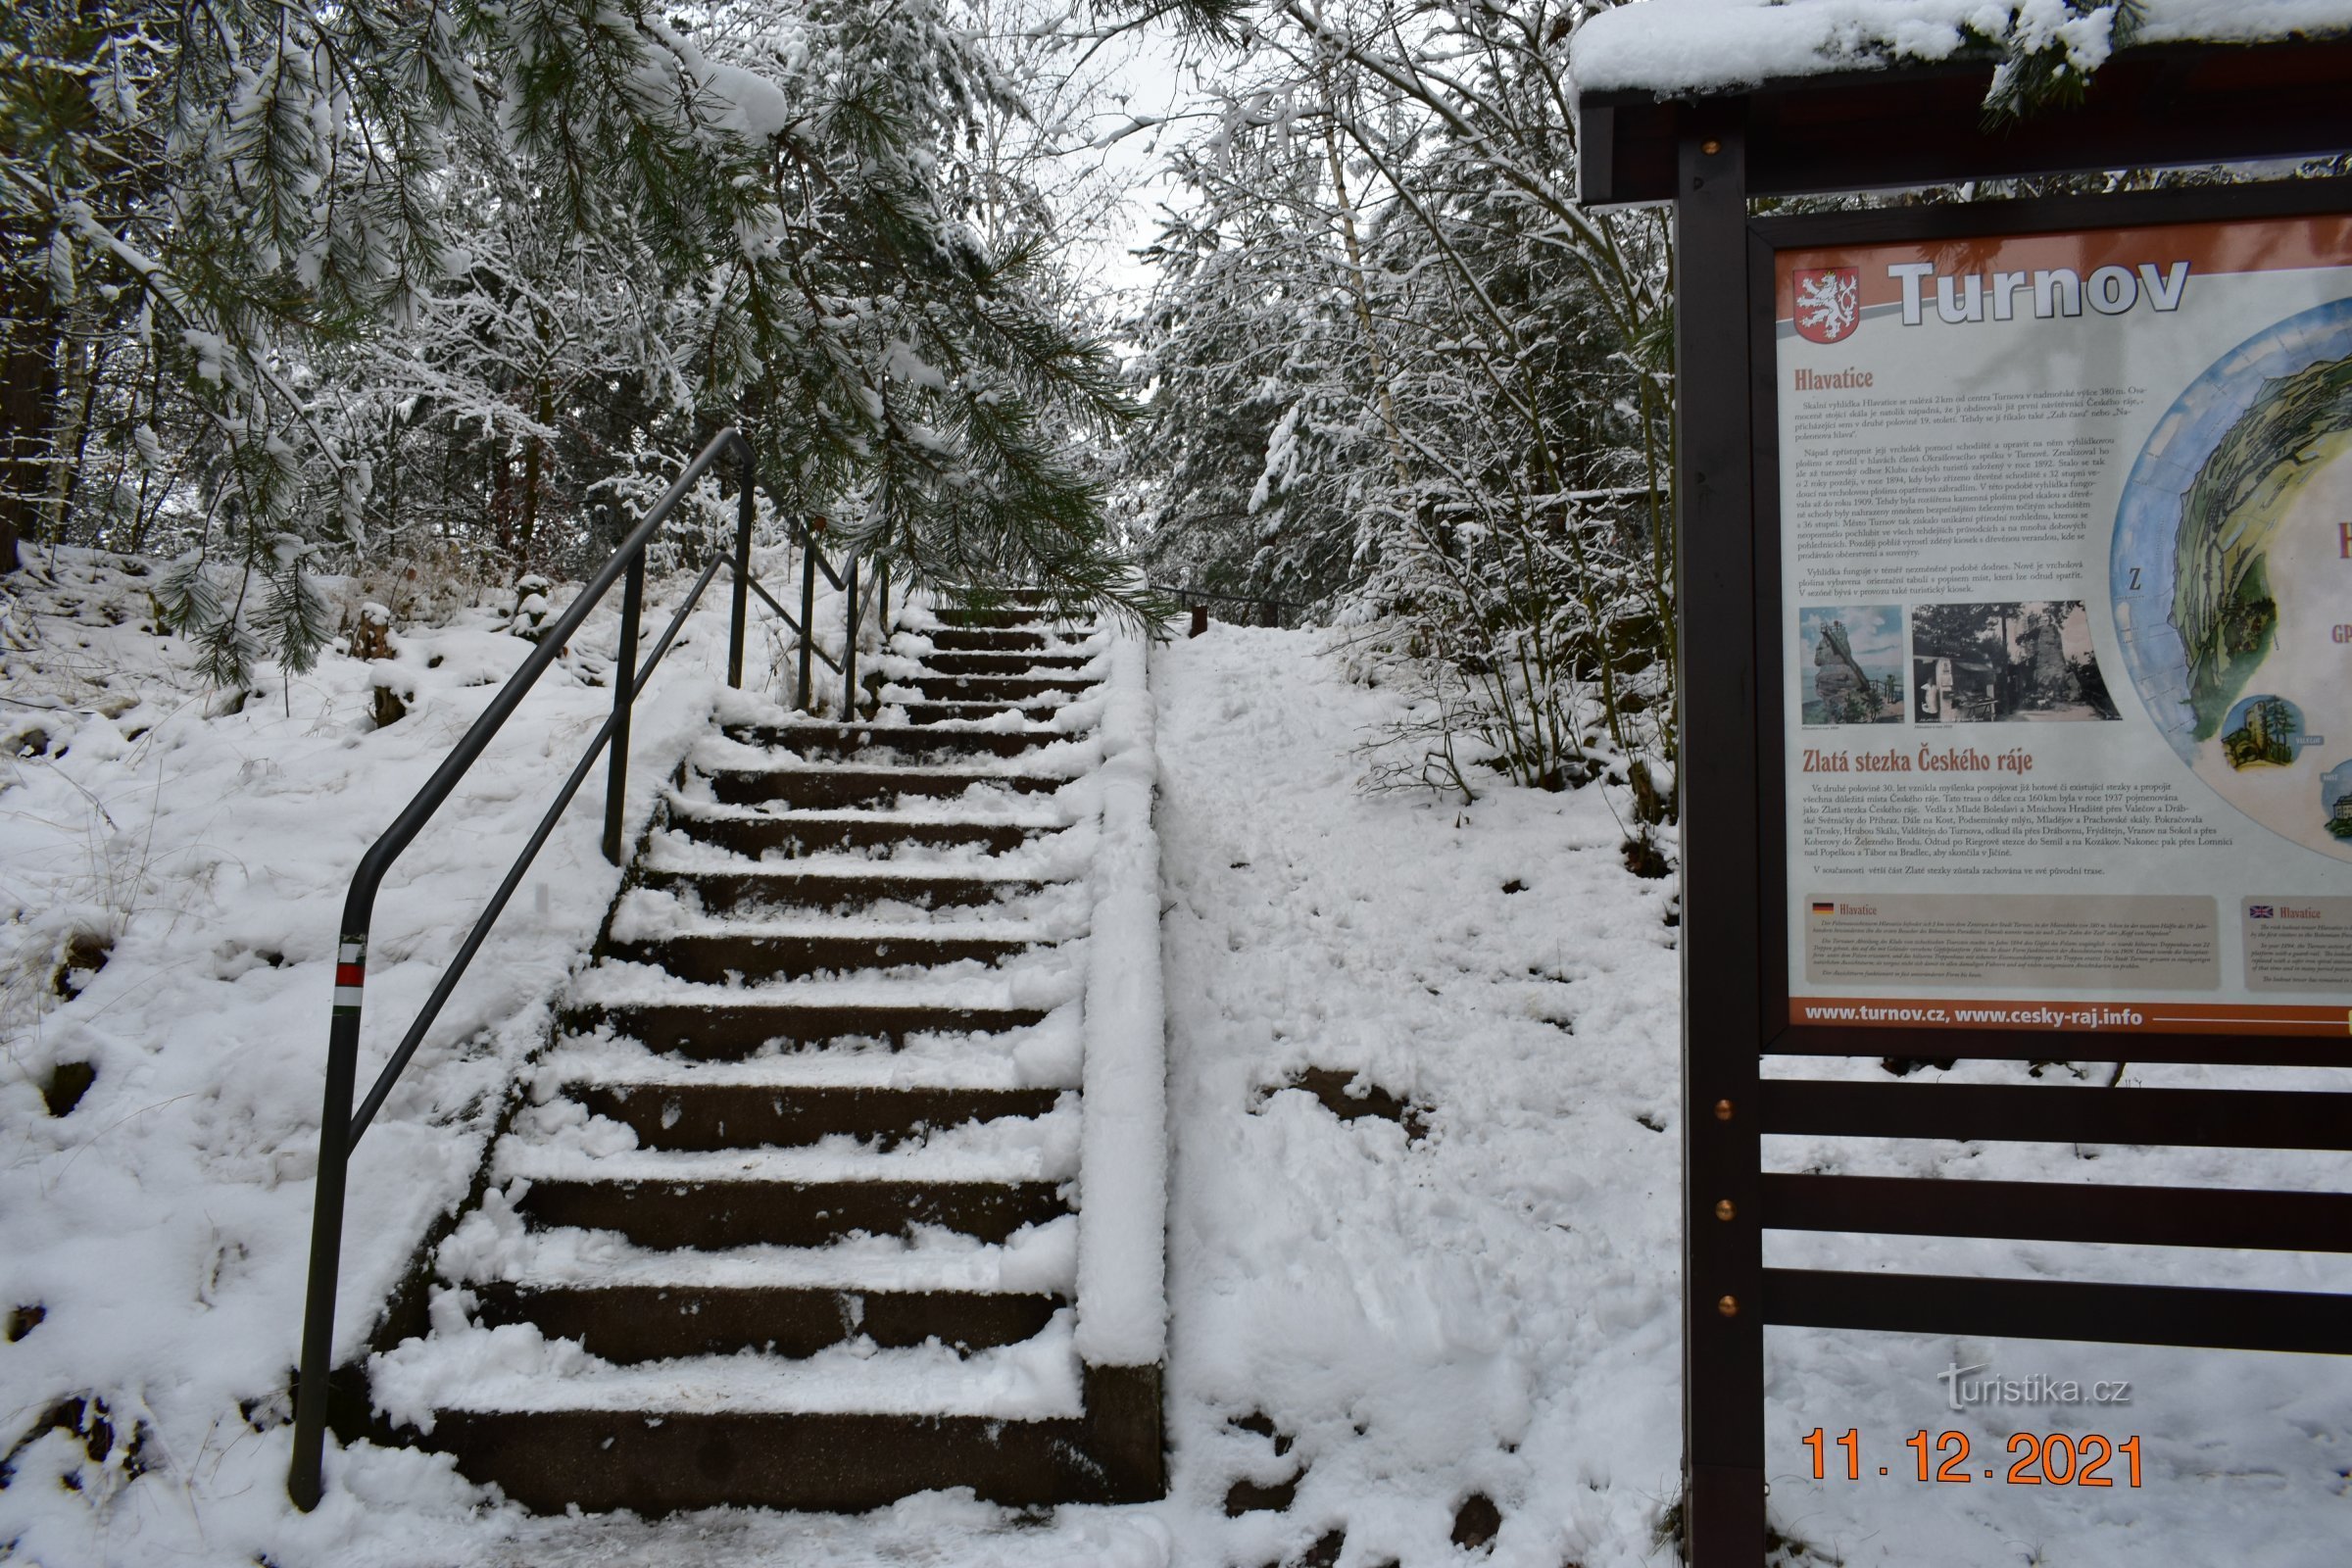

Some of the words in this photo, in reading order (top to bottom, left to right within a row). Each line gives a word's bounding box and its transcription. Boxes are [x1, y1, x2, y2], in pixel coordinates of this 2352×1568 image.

[1887, 261, 2191, 325] Turnov
[1794, 368, 1873, 391] Hlavatice
[2128, 567, 2141, 590] Z
[1803, 749, 1849, 772] Zlatá
[1855, 749, 1911, 772] stezka
[1918, 742, 1990, 771] Českého
[1997, 747, 2033, 775] ráje
[1812, 784, 1822, 792] Ve
[1896, 784, 1907, 792] let
[1908, 784, 1937, 792] vznikla
[1977, 784, 2018, 794] pospojovat
[2106, 783, 2131, 793] stezky
[2140, 783, 2171, 793] propojit
[1803, 805, 1819, 815] jako
[1843, 805, 1867, 813] stezka
[1925, 805, 1947, 813] Vedla
[1983, 805, 2018, 813] Boleslavi
[2026, 805, 2067, 813] Mnichova
[1856, 816, 1867, 824] do
[1844, 827, 1874, 835] Hrubou
[1937, 827, 1948, 835] do
[1985, 827, 2011, 835] odkud
[2127, 827, 2156, 835] Vranov
[2169, 827, 2192, 835] Sokol
[1804, 838, 1841, 848] Koberovy
[1842, 838, 1852, 846] do
[1924, 838, 1951, 846] Odtud
[1952, 840, 1963, 848] po
[2002, 838, 2025, 846] stezce
[2027, 838, 2038, 846] do
[2040, 838, 2063, 846] Semil
[2123, 838, 2159, 846] Nakonec
[2161, 838, 2176, 848] pak
[2198, 838, 2233, 846] Lomnici
[1804, 848, 1819, 856] nad
[1820, 848, 1855, 858] Popelkou
[1933, 849, 1947, 859] aby
[1927, 867, 1951, 877] stezky
[1839, 903, 1878, 916] Hlavatice
[2279, 906, 2322, 919] Hlavatice
[1805, 1005, 1950, 1024] www.turnov.cz,
[1955, 1007, 2143, 1028] www.cesky-raj.info
